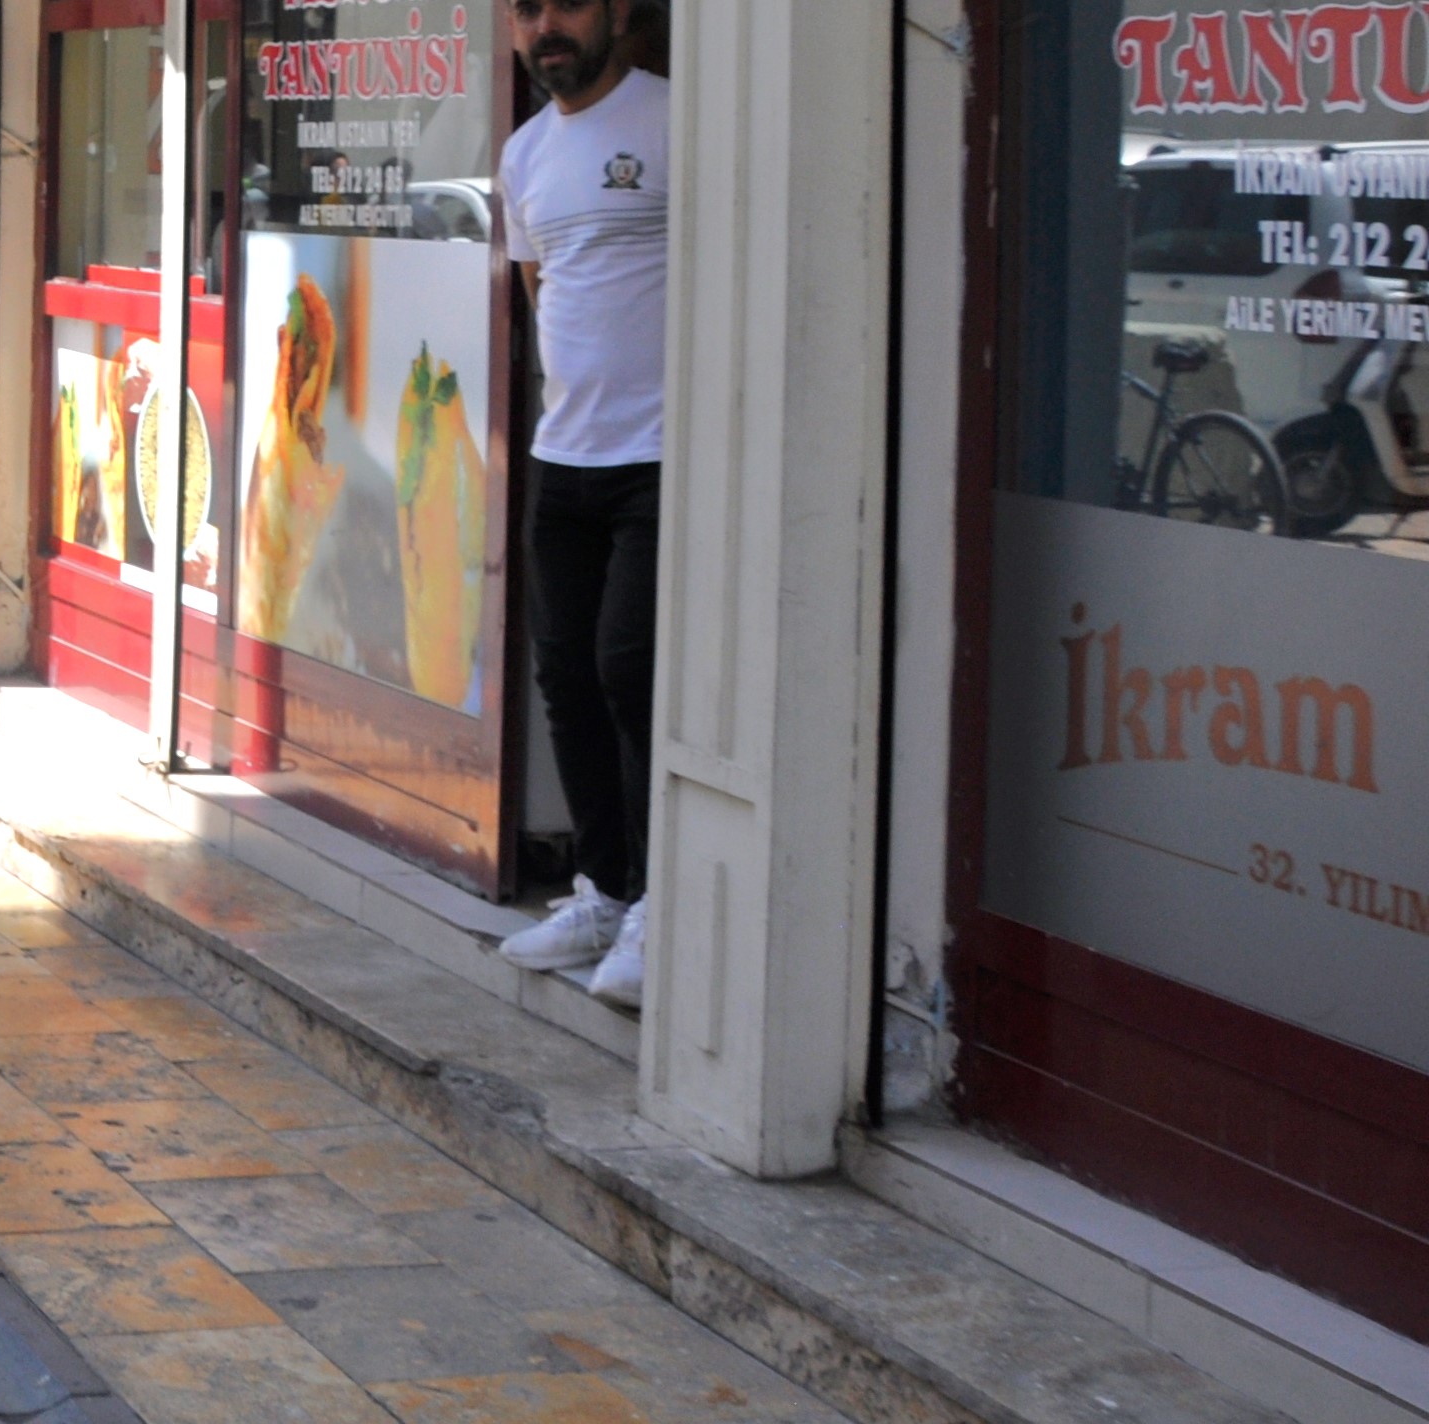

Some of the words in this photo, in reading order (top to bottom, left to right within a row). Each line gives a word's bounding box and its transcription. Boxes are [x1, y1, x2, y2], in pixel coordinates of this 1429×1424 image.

[259, 5, 467, 101] TANTUNİSİ
[1258, 219, 1319, 265] TEL:
[1328, 222, 1392, 268] 212
[1401, 223, 1429, 271] 2
[1224, 296, 1275, 333] AİLE
[1280, 298, 1380, 340] YERİMİZ
[1057, 600, 1381, 795] İkram
[1247, 842, 1308, 897] 32.
